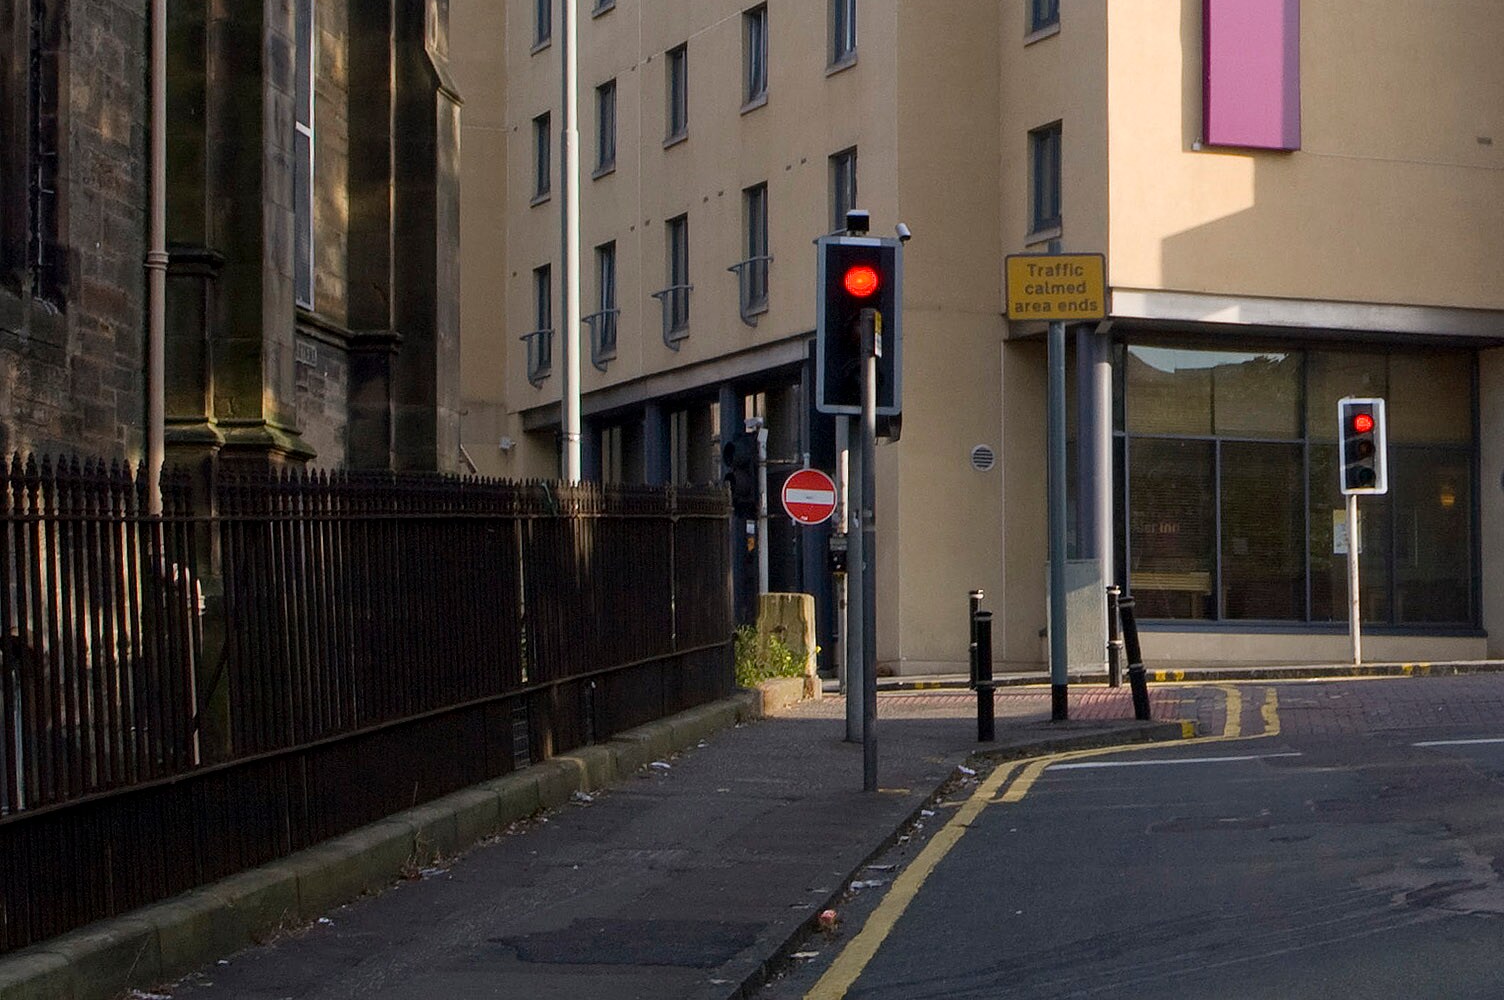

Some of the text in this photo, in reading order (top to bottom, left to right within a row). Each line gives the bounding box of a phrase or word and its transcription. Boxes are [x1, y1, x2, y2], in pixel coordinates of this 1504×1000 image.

[1026, 263, 1084, 277] Traffic
[1024, 280, 1087, 295] calmed
[1015, 299, 1098, 313] area ends
